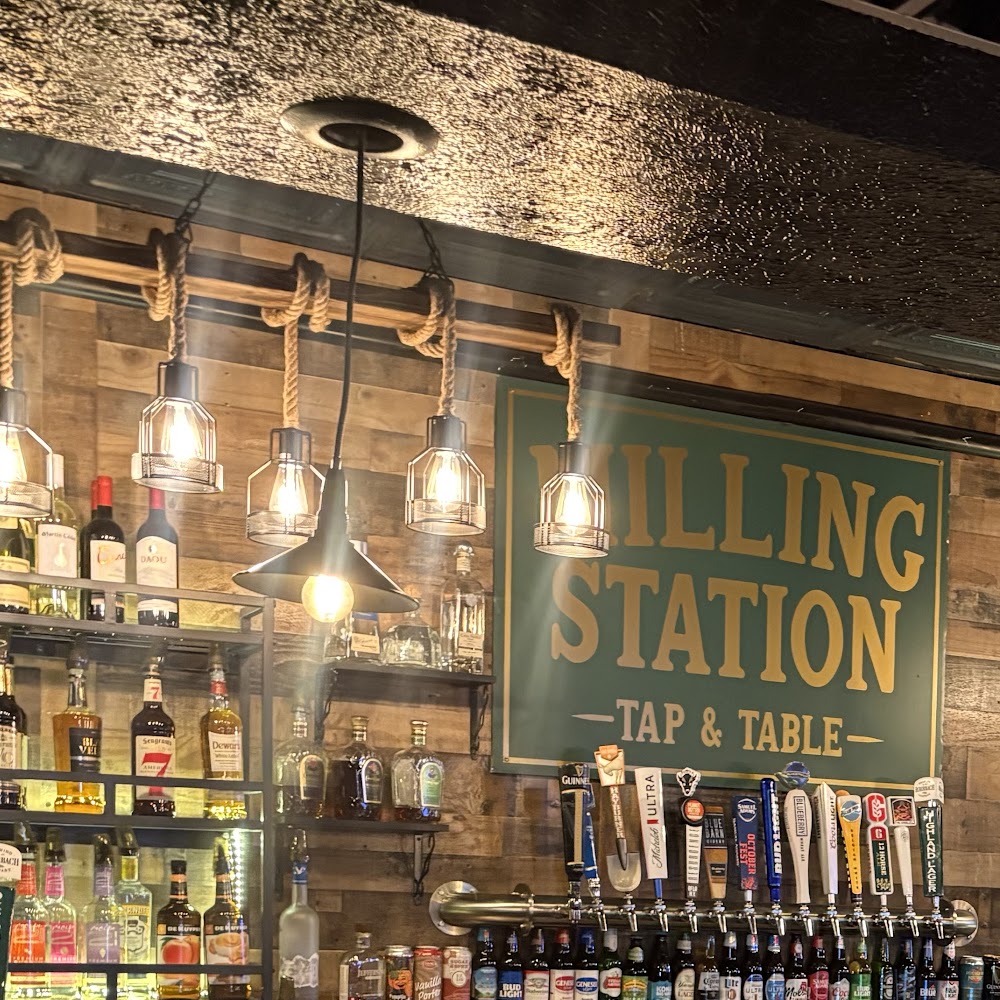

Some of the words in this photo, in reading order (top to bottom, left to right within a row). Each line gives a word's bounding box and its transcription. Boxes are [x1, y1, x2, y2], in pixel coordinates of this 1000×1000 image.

[551, 559, 902, 694] STATION
[150, 687, 160, 700] 7
[616, 698, 685, 745] TAP
[700, 706, 723, 748] &
[738, 709, 844, 757] TABLE
[645, 774, 655, 816] ULTRA
[797, 798, 807, 835] BLUEBERRY
[650, 826, 662, 869] Michelob
[925, 810, 936, 859] HIGHLAND
[739, 842, 748, 867] FEST
[747, 833, 756, 875] OCTOBER
[773, 844, 783, 874] BUD
[928, 862, 937, 893] LAGER
[414, 976, 442, 991] Vanilla
[502, 983, 522, 991] BUD
[724, 979, 739, 988] Lite
